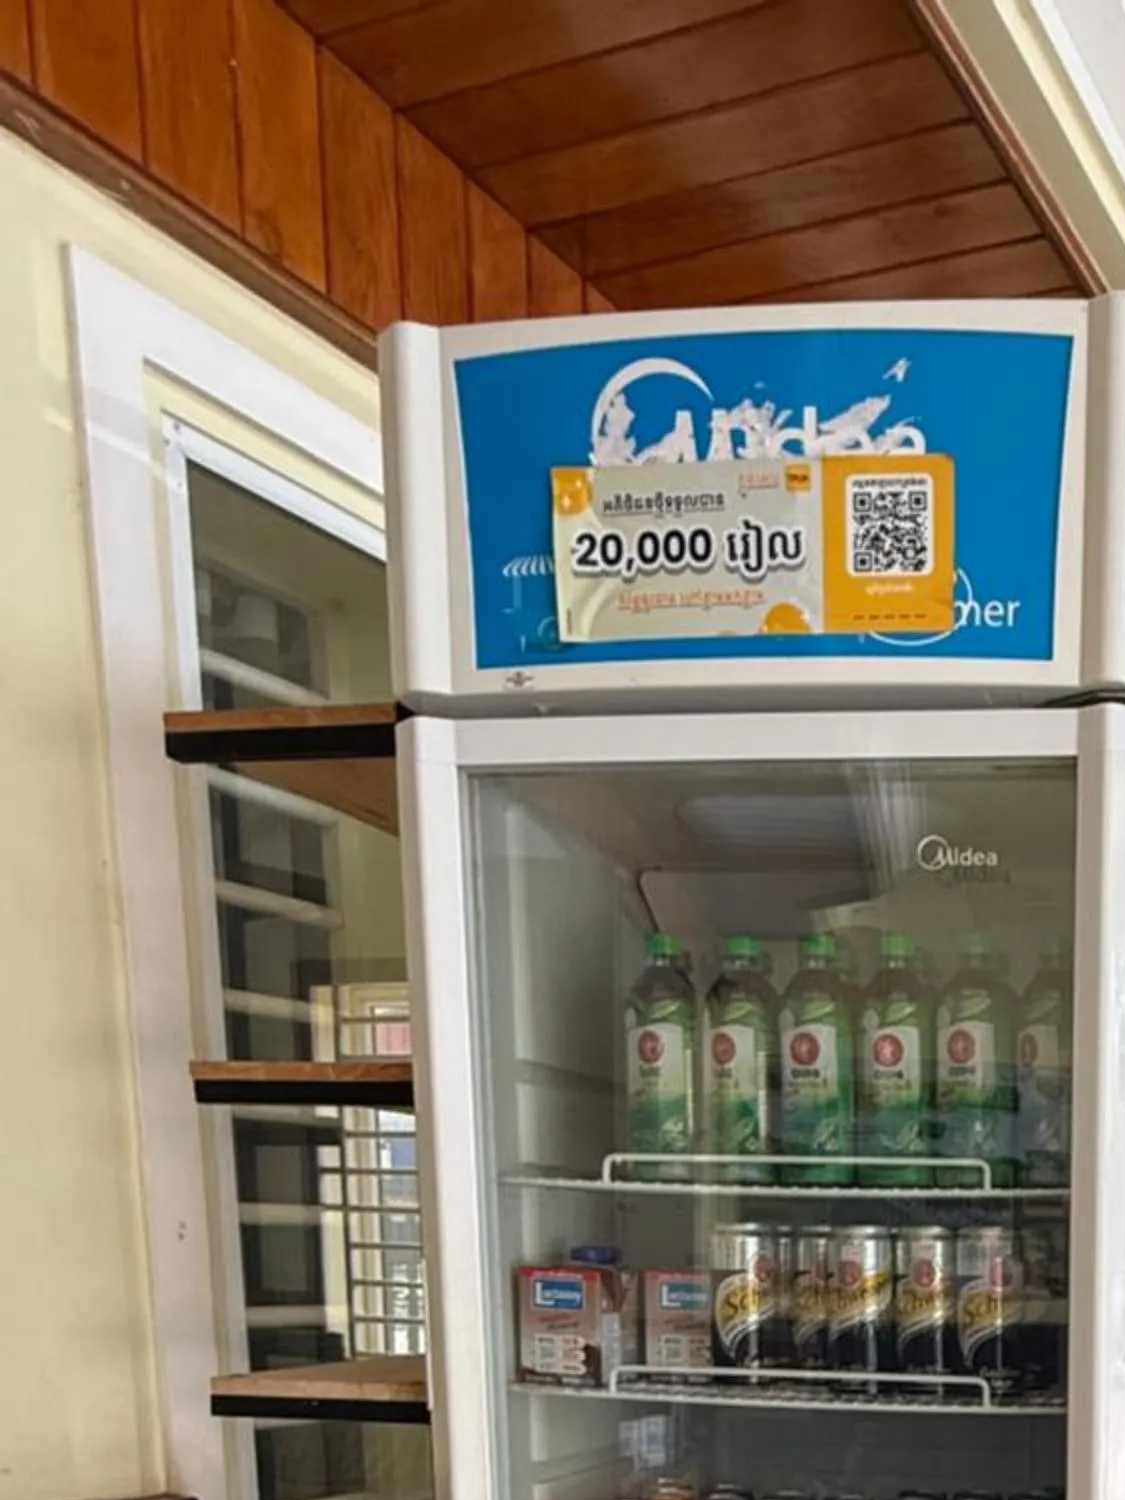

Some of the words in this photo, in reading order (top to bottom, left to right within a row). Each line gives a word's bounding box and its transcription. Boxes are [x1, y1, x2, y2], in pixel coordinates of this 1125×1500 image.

[574, 527, 713, 573] 20,000
[726, 519, 803, 573] រៀល
[917, 834, 999, 871] Midea
